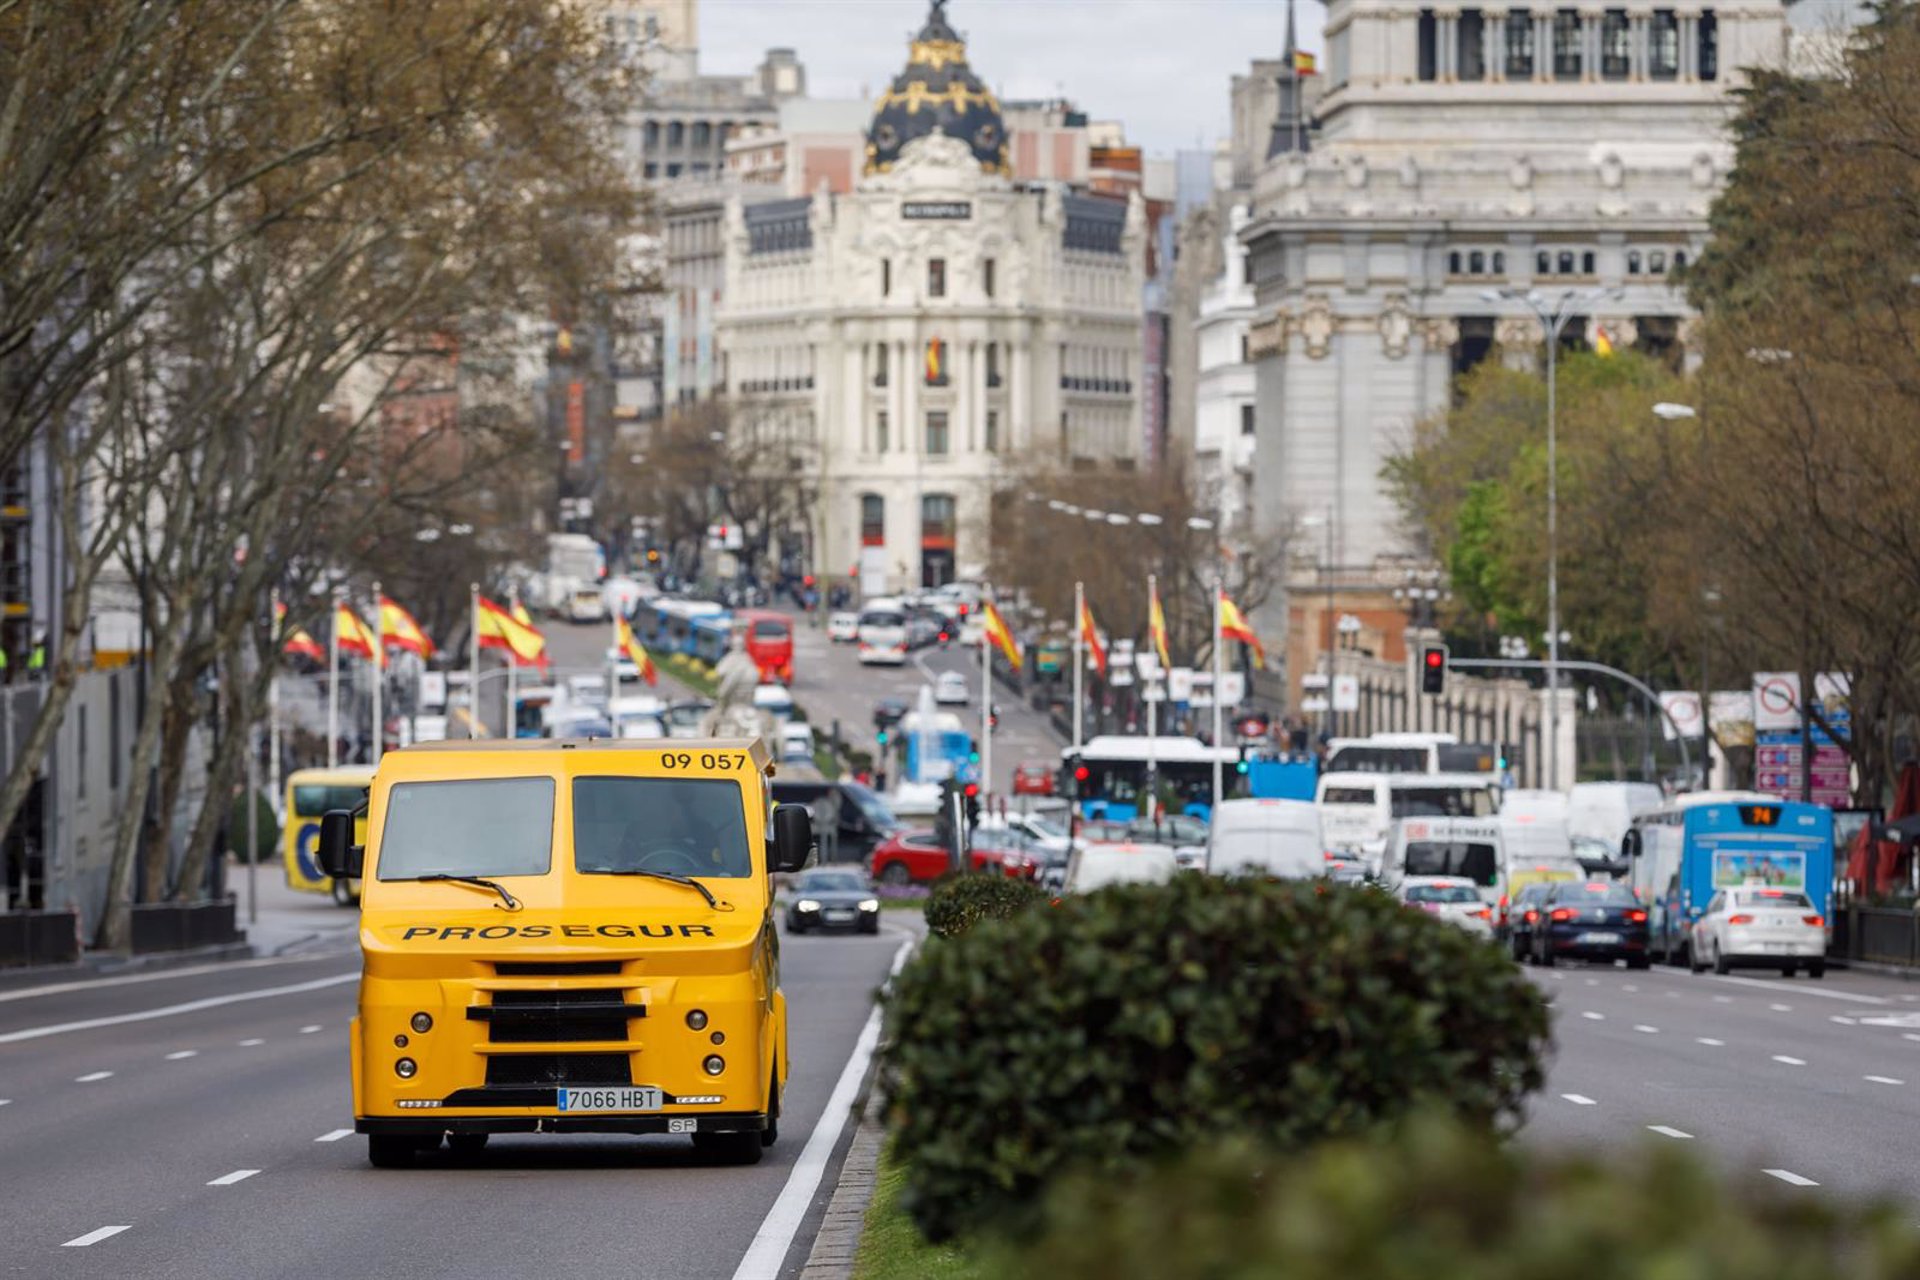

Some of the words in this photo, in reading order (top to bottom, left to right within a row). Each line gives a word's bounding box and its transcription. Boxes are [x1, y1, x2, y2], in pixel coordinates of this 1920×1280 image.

[661, 753, 692, 769] 09
[701, 754, 745, 770] 057
[402, 924, 716, 941] PROSEGUR
[568, 1091, 616, 1108] 7066
[621, 1091, 655, 1108] HBT
[670, 1119, 696, 1132] SP
